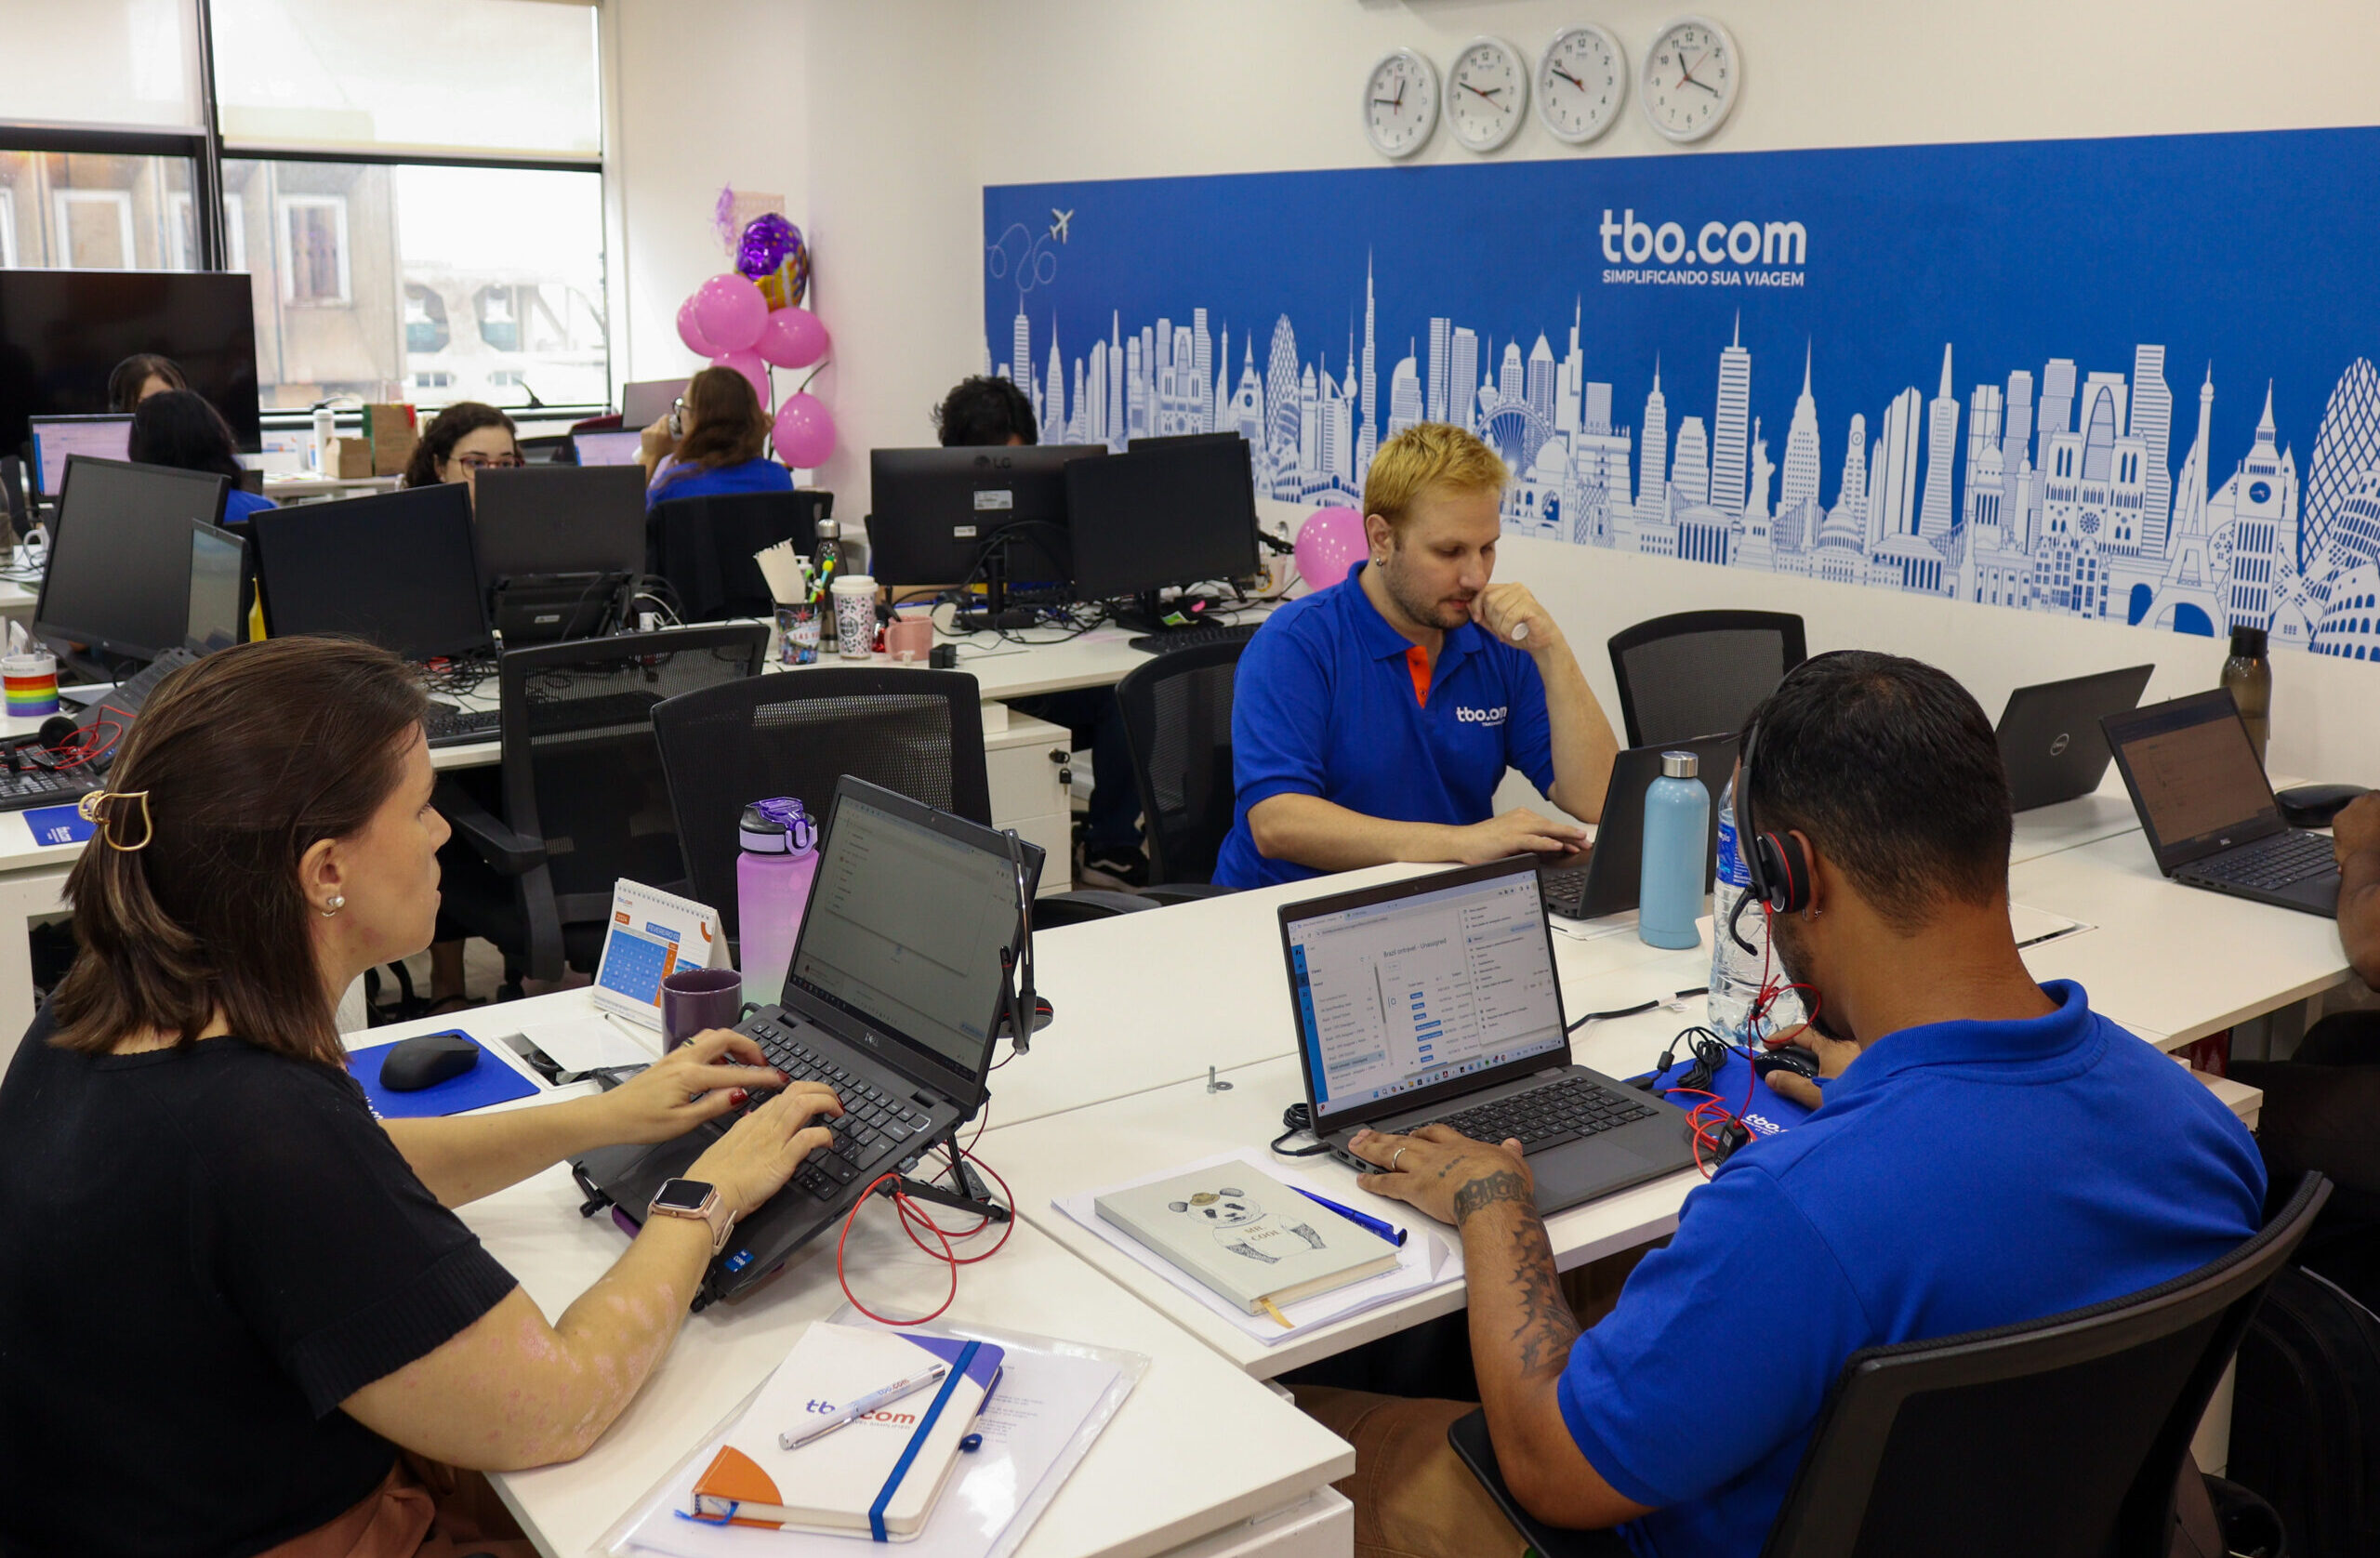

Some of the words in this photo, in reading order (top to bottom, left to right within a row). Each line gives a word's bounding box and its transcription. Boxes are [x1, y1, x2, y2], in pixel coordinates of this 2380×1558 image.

[1599, 209, 1807, 265] tbo.com
[1603, 270, 1709, 284] SIMPLIFICANDO
[1711, 271, 1741, 285] SUA
[1744, 271, 1805, 287] VIAGEM
